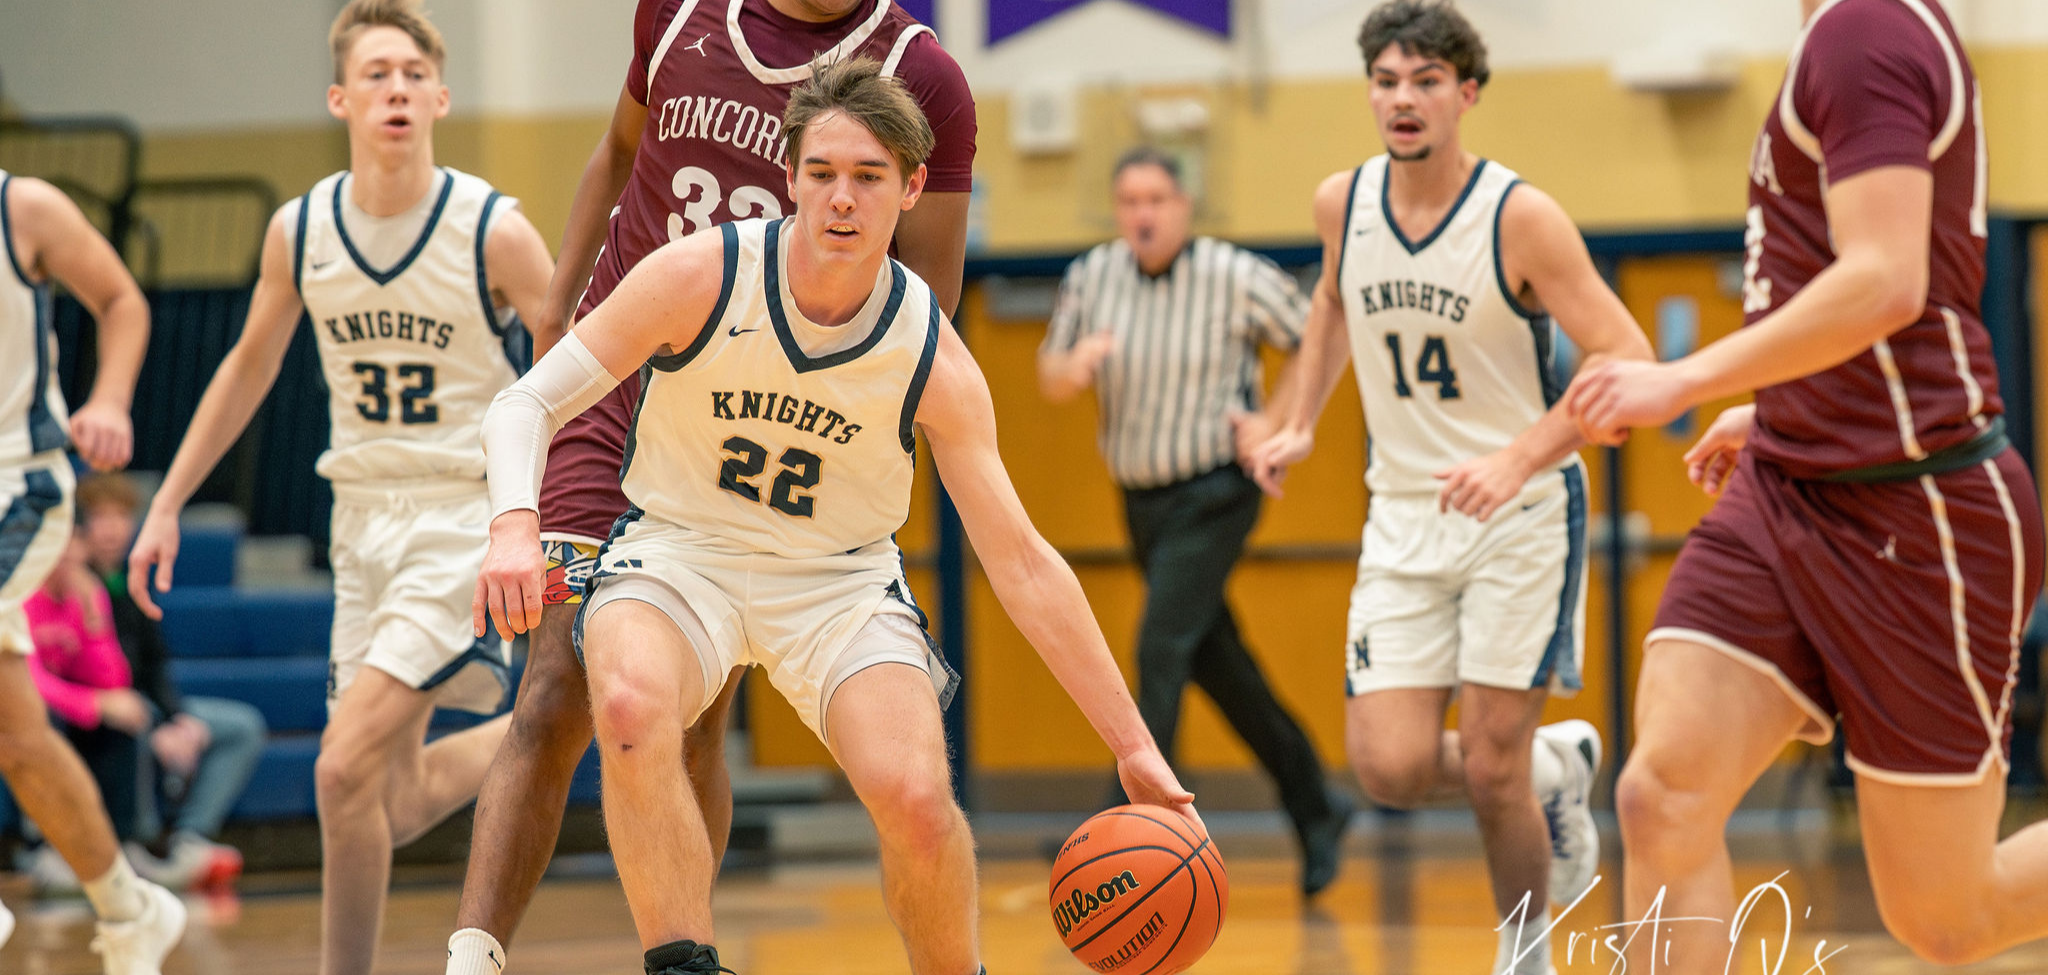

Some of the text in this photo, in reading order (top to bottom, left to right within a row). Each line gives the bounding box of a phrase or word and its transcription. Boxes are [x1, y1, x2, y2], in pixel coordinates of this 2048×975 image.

[325, 311, 454, 349] KNIGHTS
[1361, 280, 1470, 323] KNIGHTS
[352, 361, 439, 425] 32
[1384, 331, 1463, 400] 14
[711, 390, 863, 444] KNIGHTS
[717, 433, 825, 521] 22
[1053, 869, 1140, 938] Wilson
